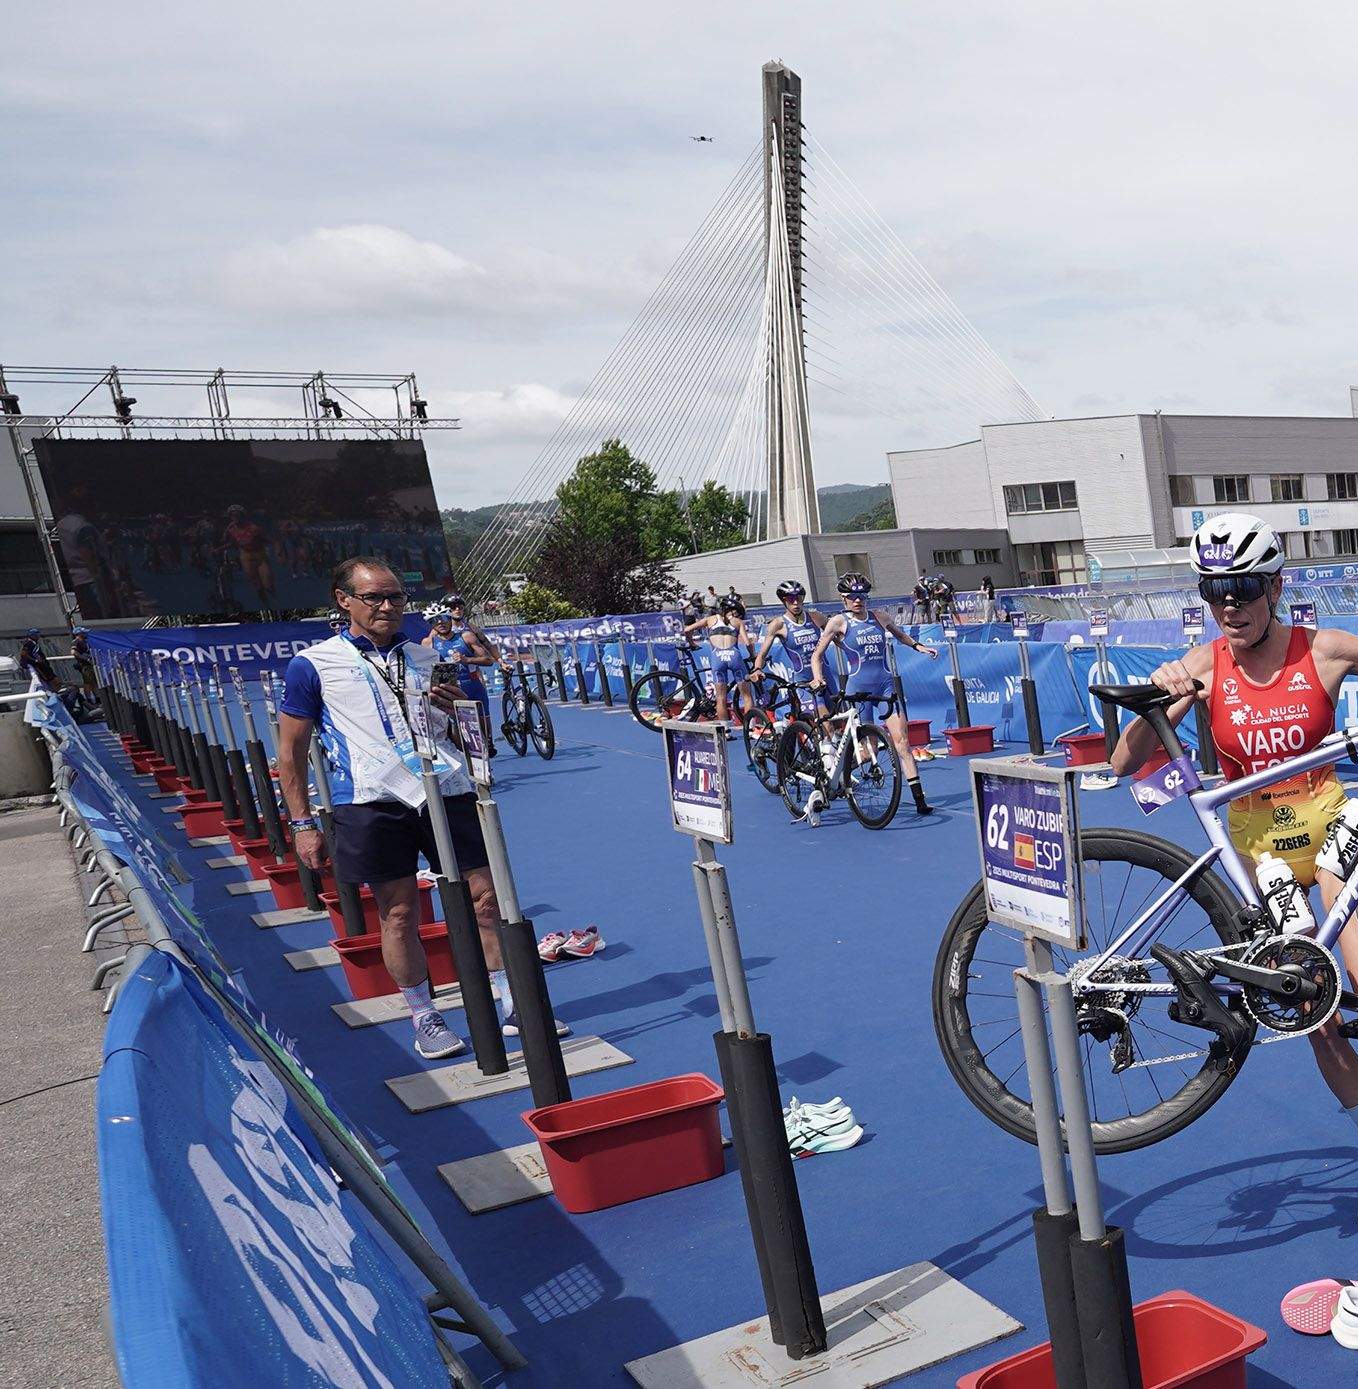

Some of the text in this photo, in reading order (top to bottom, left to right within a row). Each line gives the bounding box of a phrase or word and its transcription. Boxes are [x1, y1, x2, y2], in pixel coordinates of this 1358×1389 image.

[856, 634, 884, 645] WASSER
[864, 645, 880, 654] FRA
[1251, 710, 1263, 719] LA
[1284, 713, 1309, 721] DEPORTE
[1237, 724, 1305, 756] VARO
[677, 750, 692, 781] 64
[1164, 769, 1185, 790] 62
[987, 804, 1009, 850] 62
[1014, 806, 1036, 829] VARO
[1273, 832, 1311, 851] 226ERS
[1034, 839, 1062, 871] ESP
[1002, 867, 1028, 883] MULTISPORT
[1028, 875, 1061, 890] PONTEVEDRA
